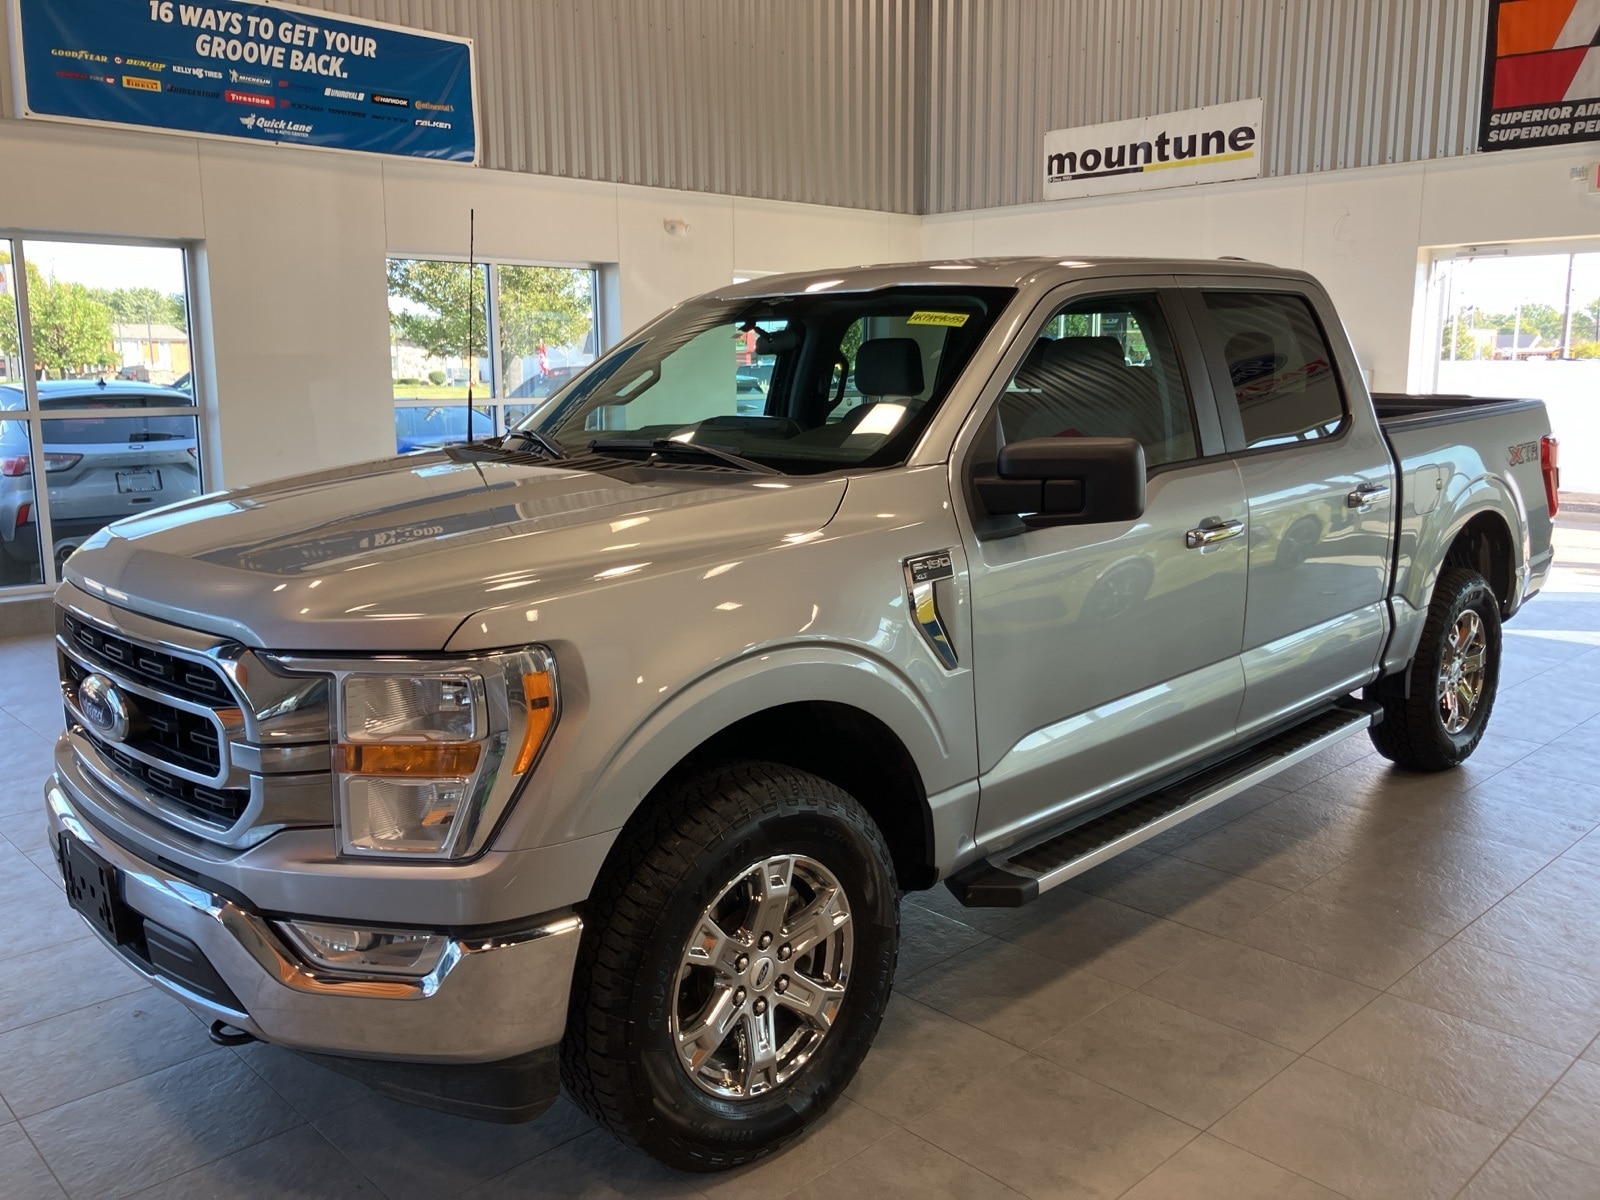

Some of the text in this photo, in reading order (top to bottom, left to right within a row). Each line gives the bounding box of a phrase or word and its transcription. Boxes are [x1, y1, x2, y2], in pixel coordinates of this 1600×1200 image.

[149, 0, 377, 58] 16 WAYS TO GET YOUR
[51, 49, 108, 63] GOODYEAR
[195, 34, 348, 78] GROOVE BACK.
[126, 58, 167, 70] DUNLOP
[172, 65, 193, 75] KELLY
[204, 69, 223, 79] TIRES
[126, 78, 158, 90] PIRELLI
[239, 75, 271, 85] MICHELIN
[230, 93, 270, 105] Firestone
[330, 89, 359, 100] UNIROYAL
[415, 101, 450, 112] Continental
[1490, 106, 1573, 126] SUPERIOR
[256, 117, 313, 133] Quick Lane
[415, 119, 451, 129] FALKEN
[1488, 123, 1571, 142] SUPERIOR
[1047, 126, 1256, 176] mountune
